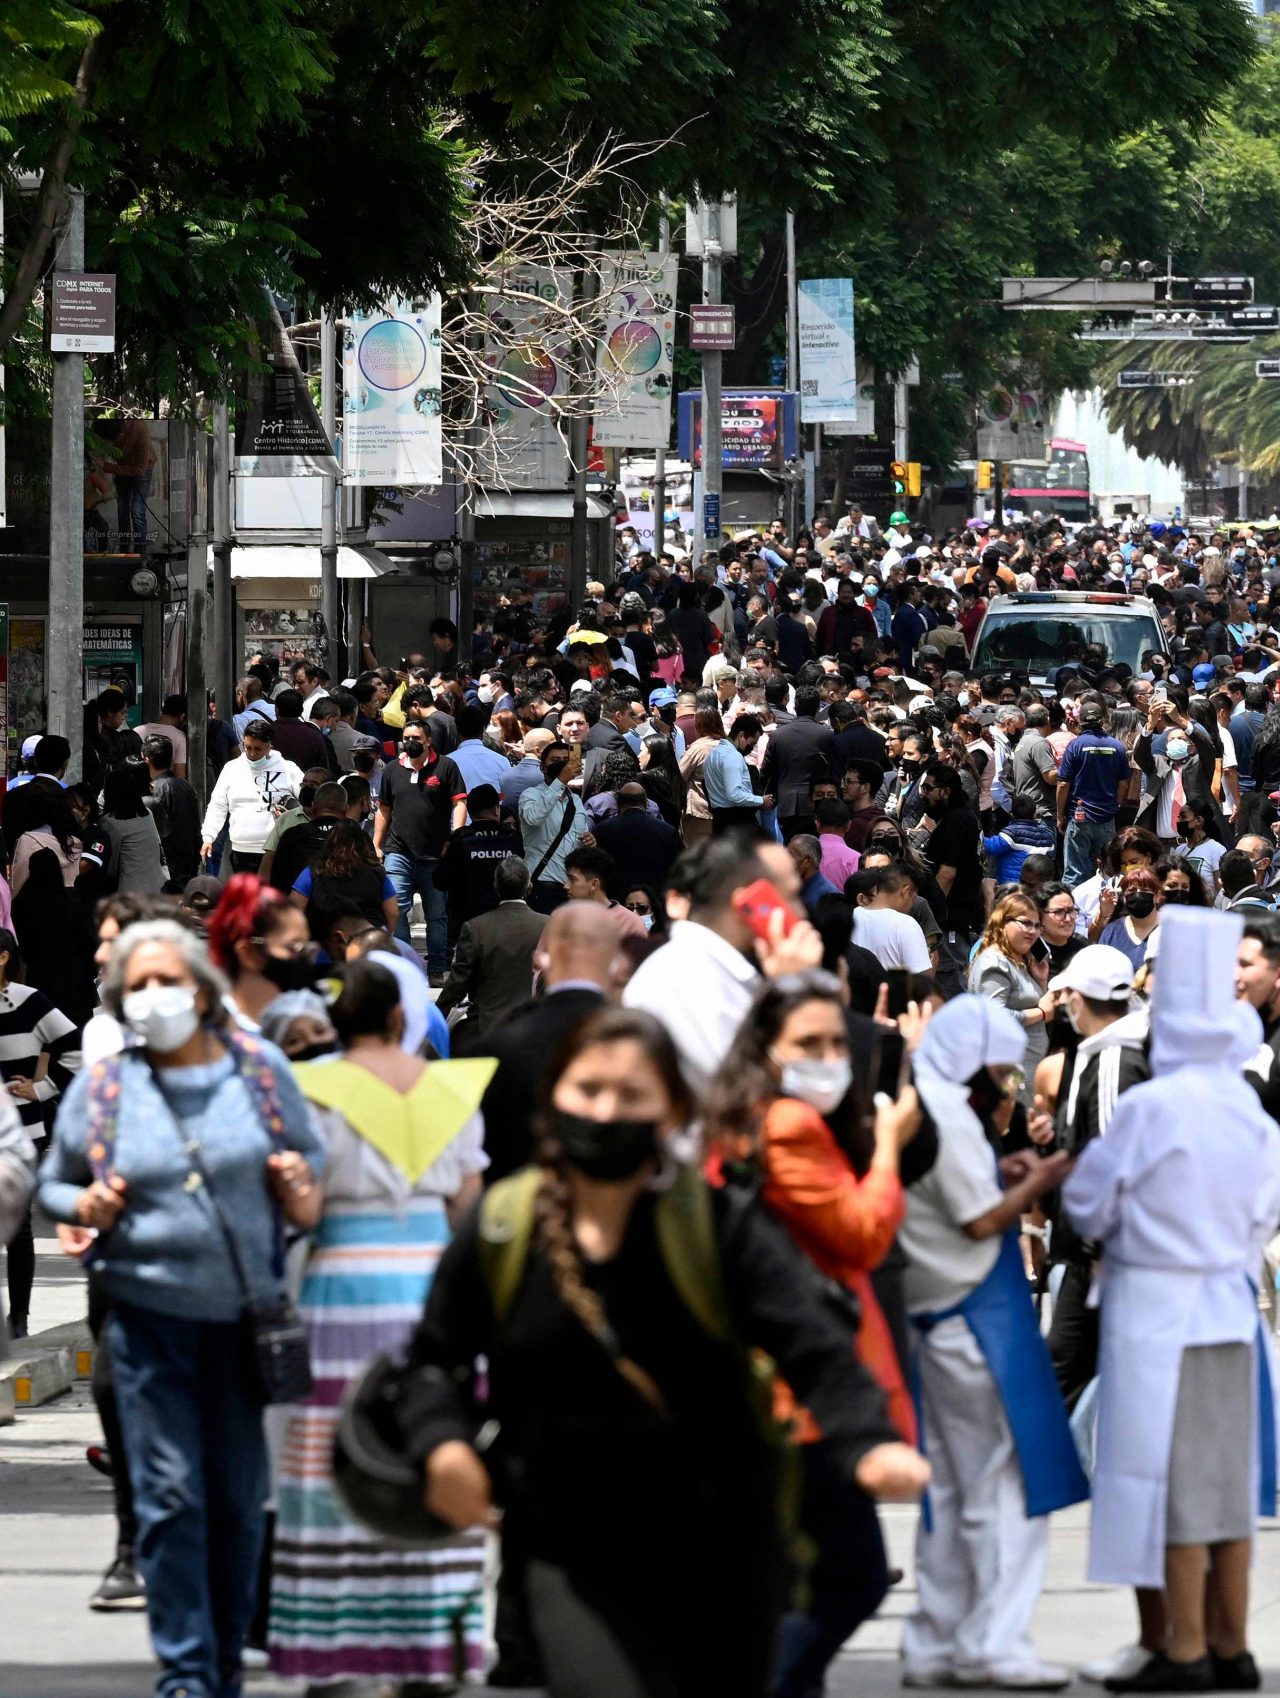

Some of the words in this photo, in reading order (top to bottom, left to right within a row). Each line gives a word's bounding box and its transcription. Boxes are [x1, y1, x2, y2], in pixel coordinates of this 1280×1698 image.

[801, 323, 836, 331] Recorrido
[801, 332, 825, 340] virtual
[801, 341, 840, 349] interactivo
[107, 530, 142, 539] Empresas
[100, 628, 121, 638] IDEAS
[122, 628, 132, 638] DE
[470, 850, 513, 859] POLICIA
